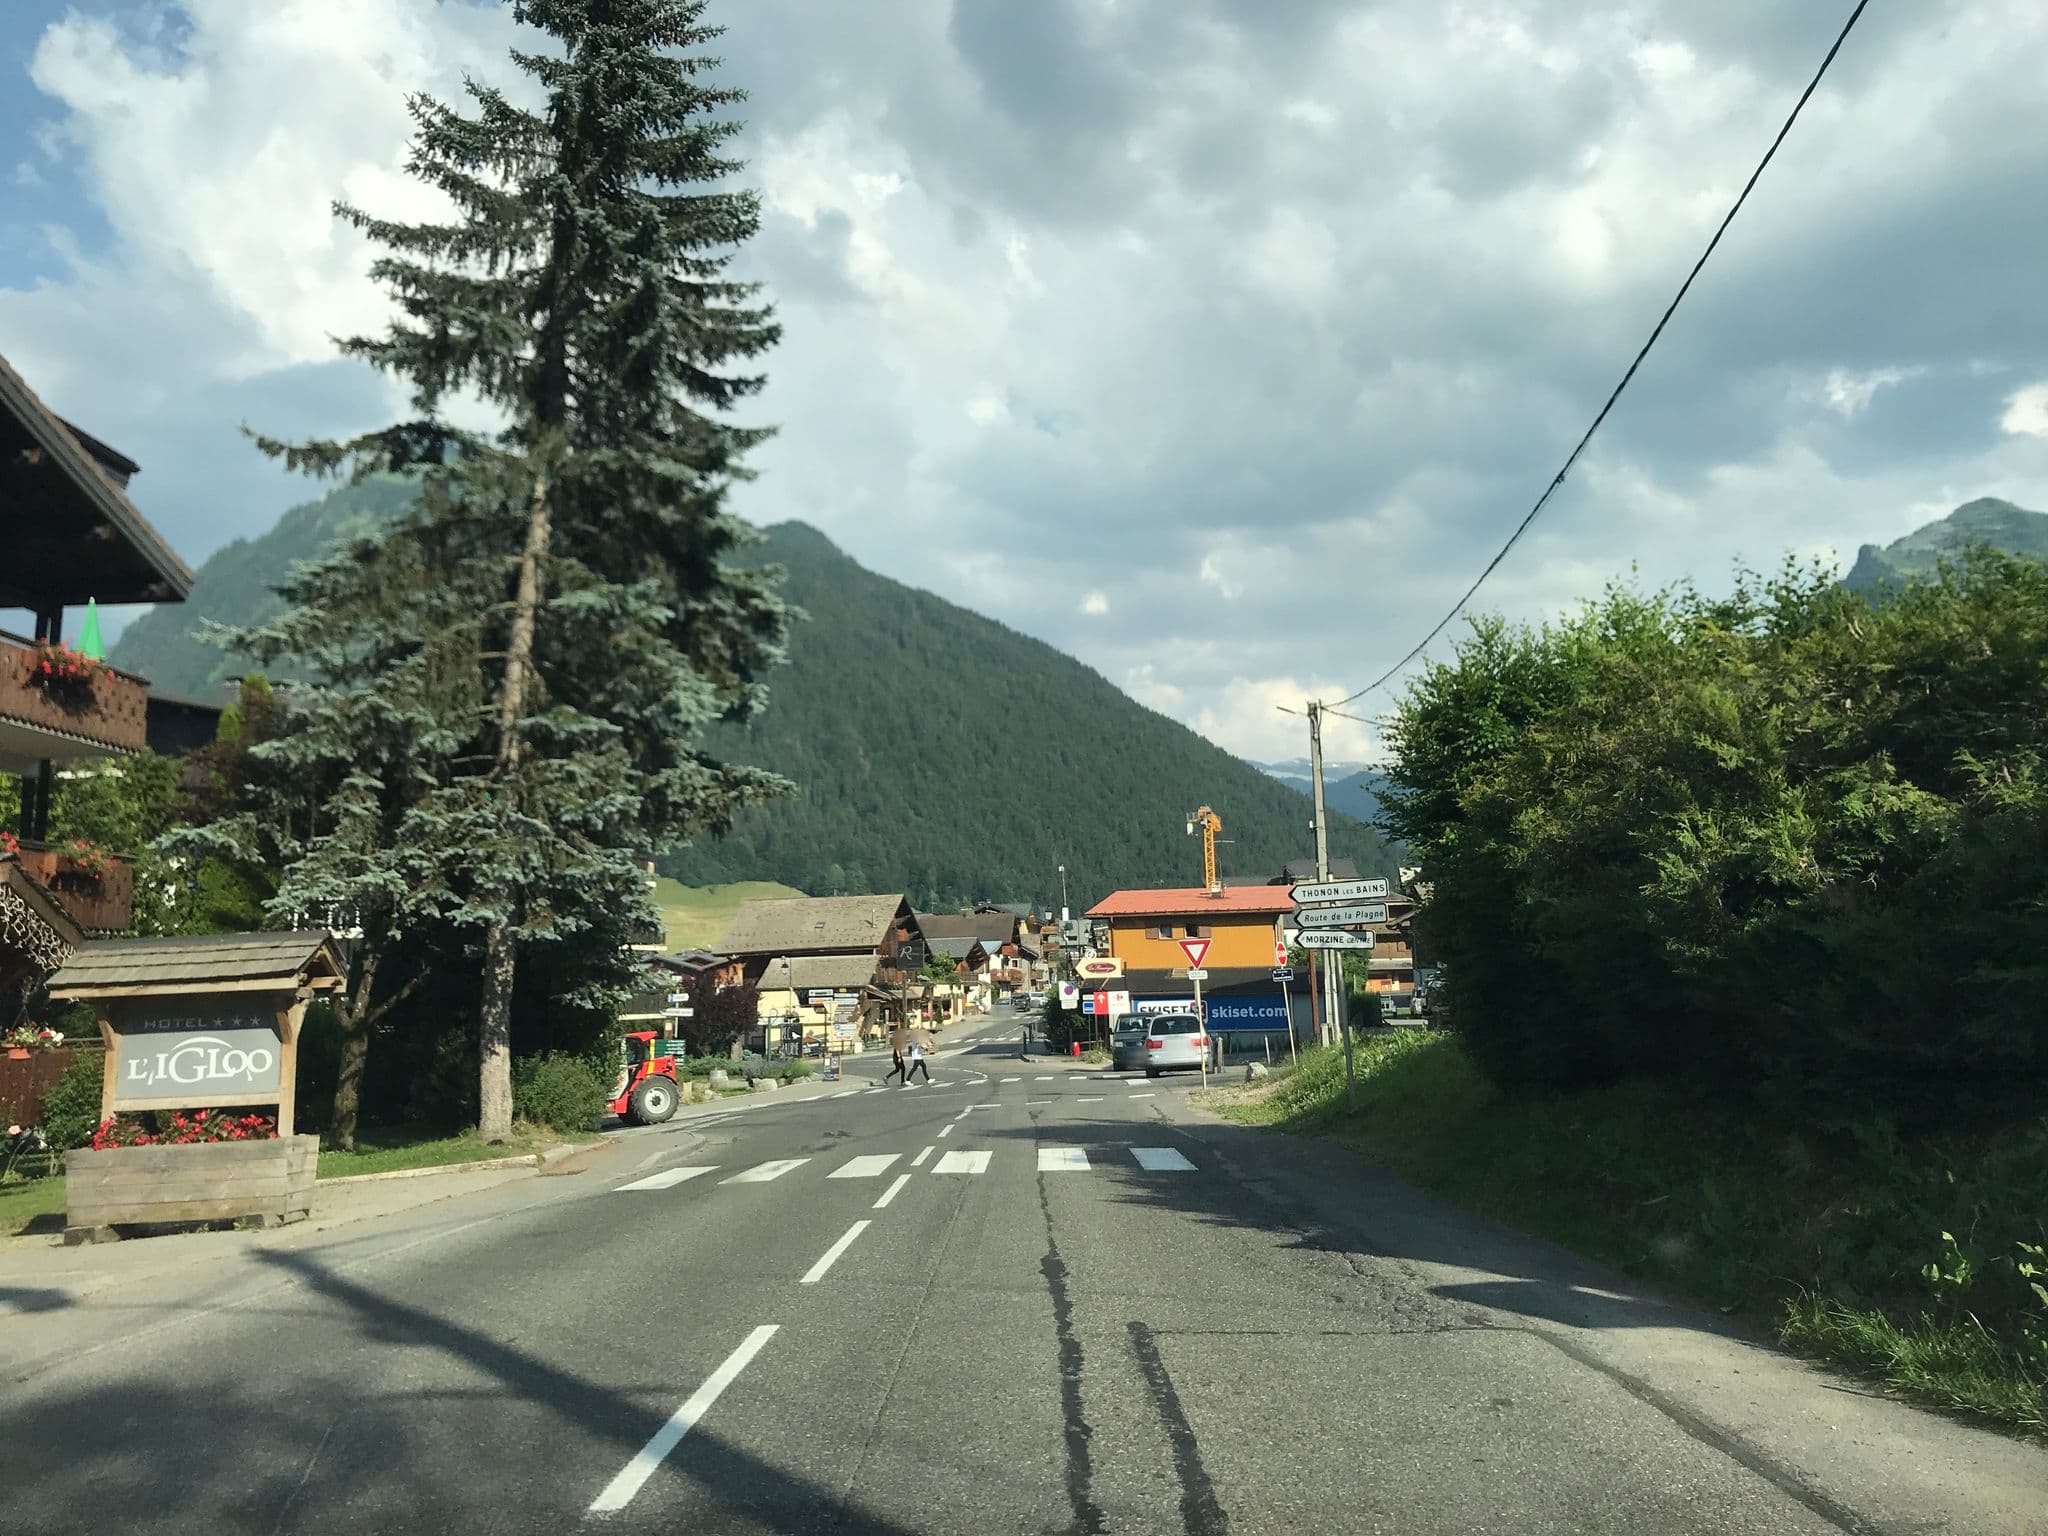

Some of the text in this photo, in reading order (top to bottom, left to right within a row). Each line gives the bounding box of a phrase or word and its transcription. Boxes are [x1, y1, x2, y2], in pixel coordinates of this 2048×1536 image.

[1301, 889, 1339, 898] THONON
[1356, 884, 1385, 894] BAINS
[1304, 910, 1384, 923] Route de la Plagne
[1305, 935, 1344, 944] MORZINE
[1211, 1005, 1288, 1019] skiset.com
[143, 1017, 208, 1029] HOTEL
[127, 1046, 273, 1084] L'IGLOO
